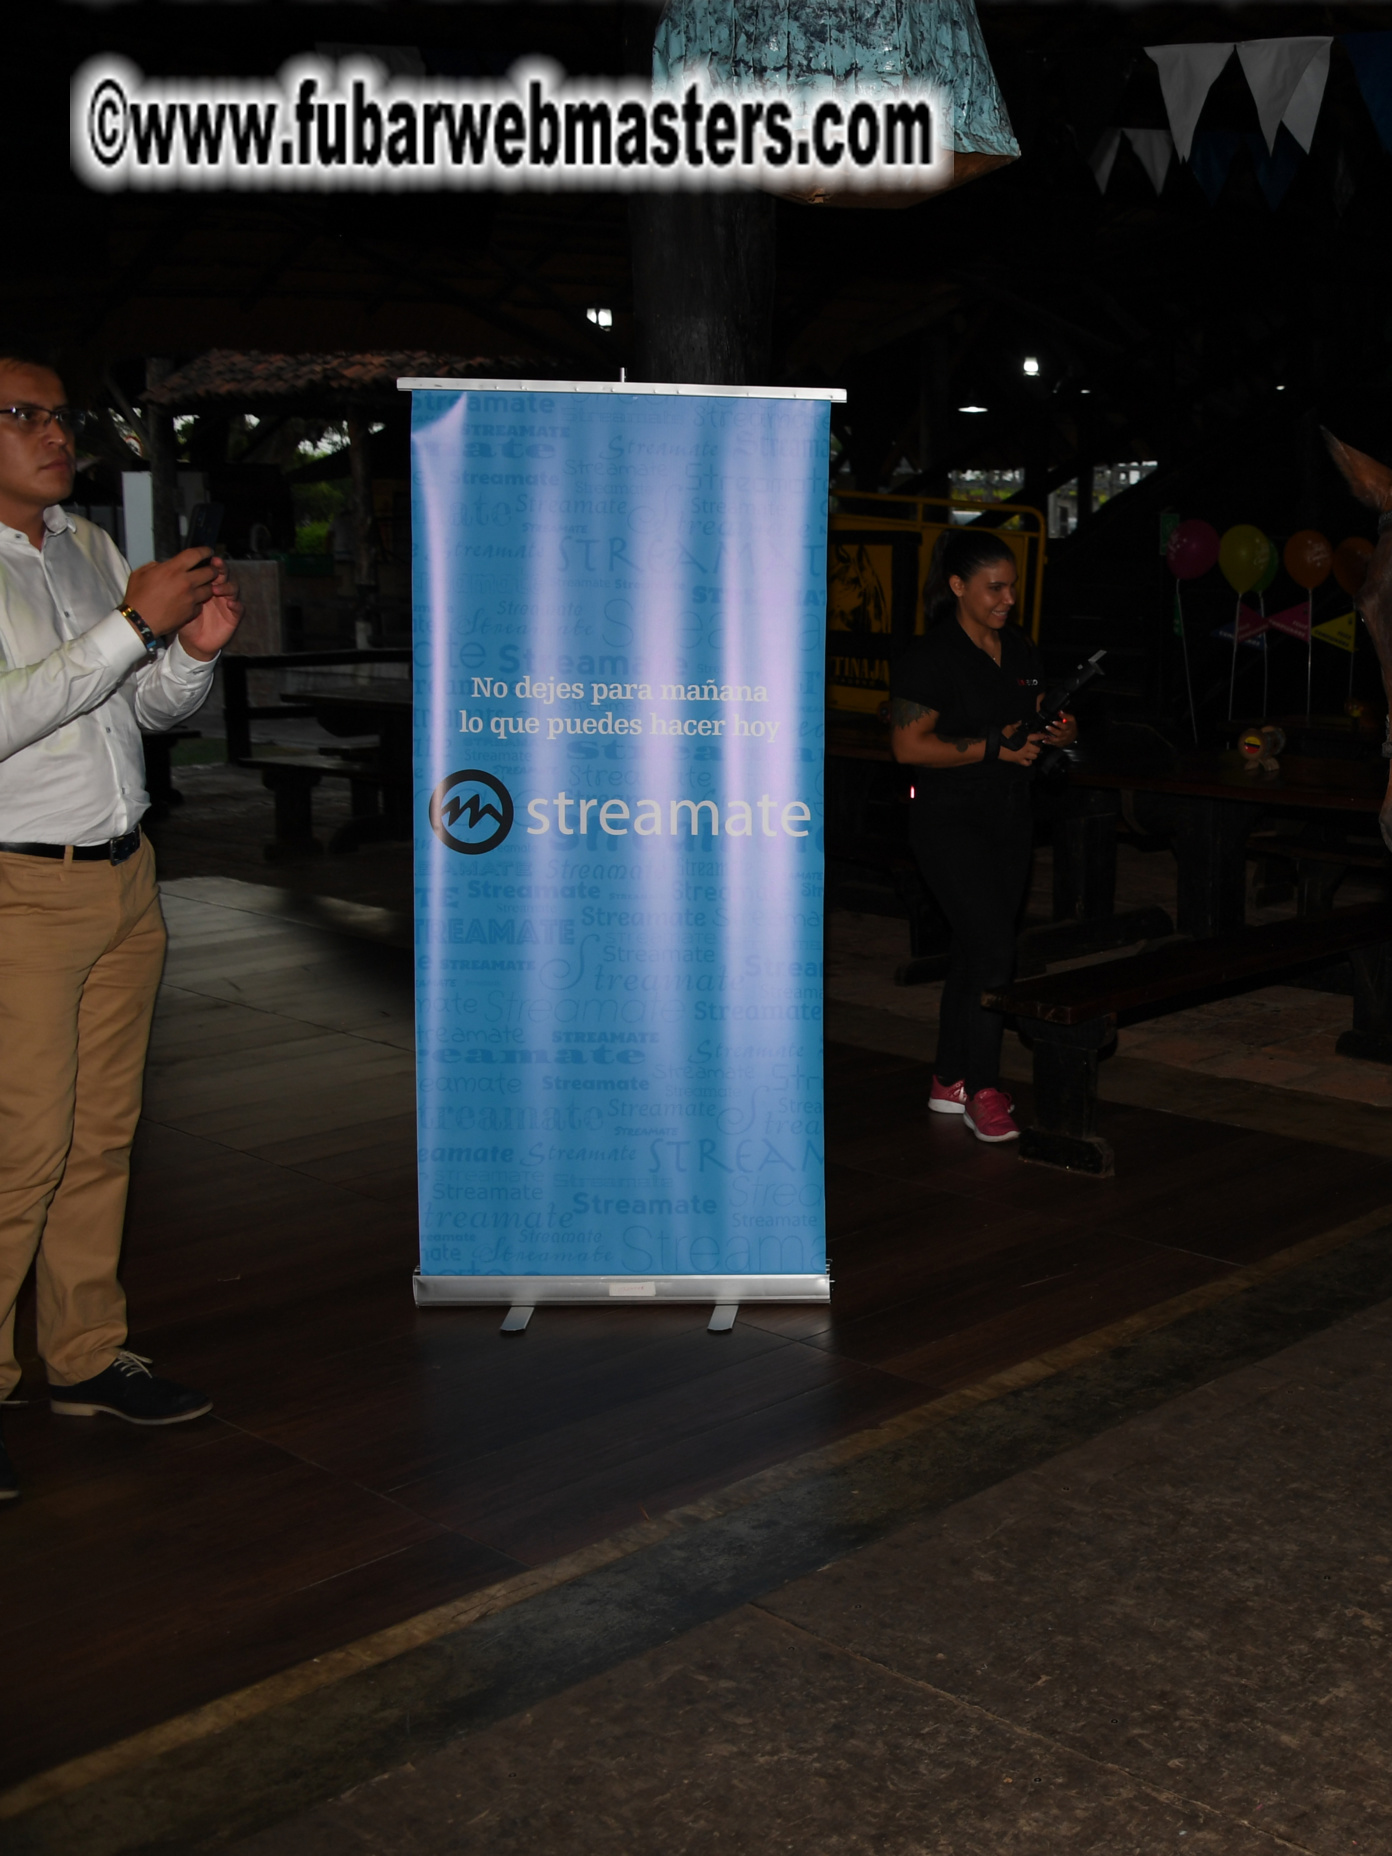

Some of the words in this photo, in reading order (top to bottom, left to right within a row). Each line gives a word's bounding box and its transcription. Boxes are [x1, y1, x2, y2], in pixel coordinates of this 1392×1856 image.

[471, 677, 508, 699] No
[515, 676, 584, 708] dejes
[591, 682, 654, 706] para
[660, 679, 769, 703] mañana
[459, 710, 483, 733] lo
[490, 714, 540, 740] que
[547, 712, 643, 740] puedes
[650, 713, 726, 737] hacer
[732, 714, 781, 743] hoy
[526, 791, 811, 838] streamate
[467, 879, 601, 899] Streamate
[580, 905, 707, 928] Streamate
[602, 945, 716, 963] Streamate
[439, 958, 537, 972] STREAMATE
[484, 988, 687, 1024] Streamate
[694, 1000, 822, 1021] Streamate
[551, 1030, 660, 1044] STREAMATE
[542, 1075, 650, 1091] Streamate
[606, 1098, 718, 1119] Streamate
[519, 1141, 637, 1167] Streamate
[432, 1182, 545, 1201] Streamate
[572, 1191, 718, 1215] Streamate
[732, 1212, 818, 1228] Streamate
